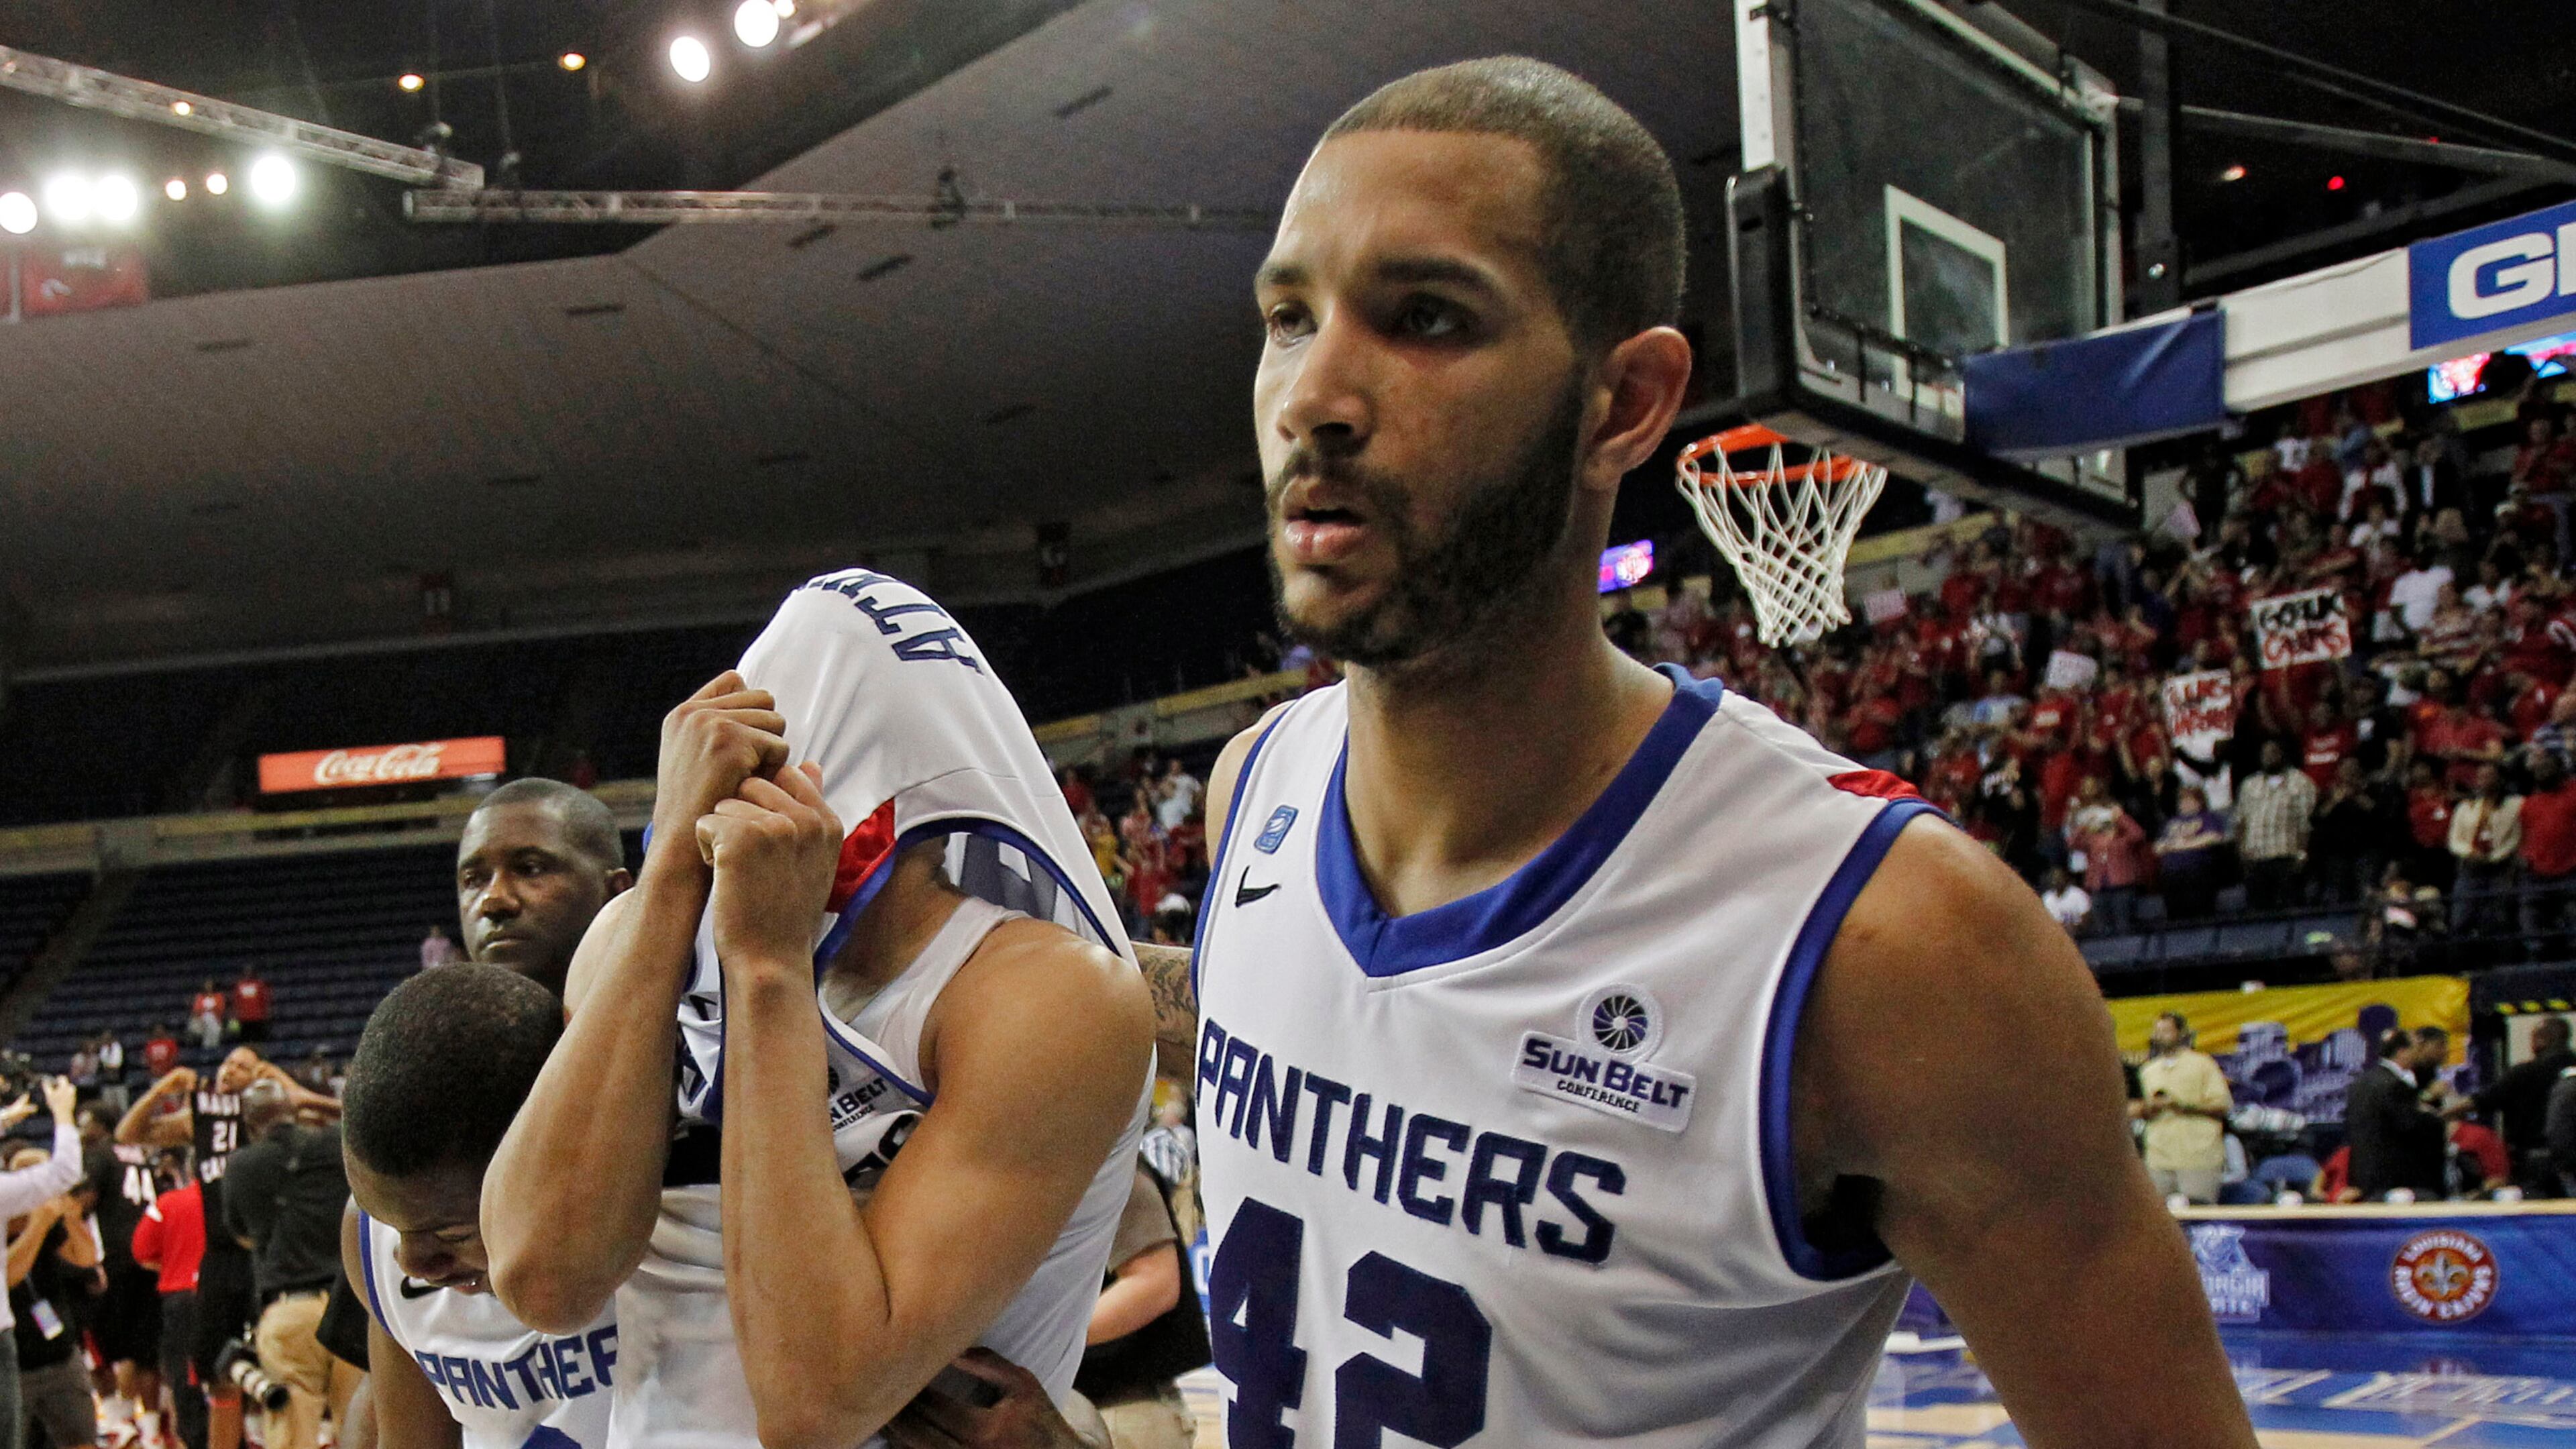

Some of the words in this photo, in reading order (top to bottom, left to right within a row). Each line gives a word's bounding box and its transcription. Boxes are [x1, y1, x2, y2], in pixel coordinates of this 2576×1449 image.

[837, 1077, 888, 1114] BELT
[1523, 1038, 1601, 1083] SUN
[1603, 1060, 1689, 1109] BELT
[1557, 1079, 1641, 1113] CONFERENCE
[213, 1120, 237, 1152] 21
[1196, 1016, 1626, 1265] PANTHERS
[1209, 1197, 1493, 1449] 42
[415, 1324, 618, 1410] PANTHER
